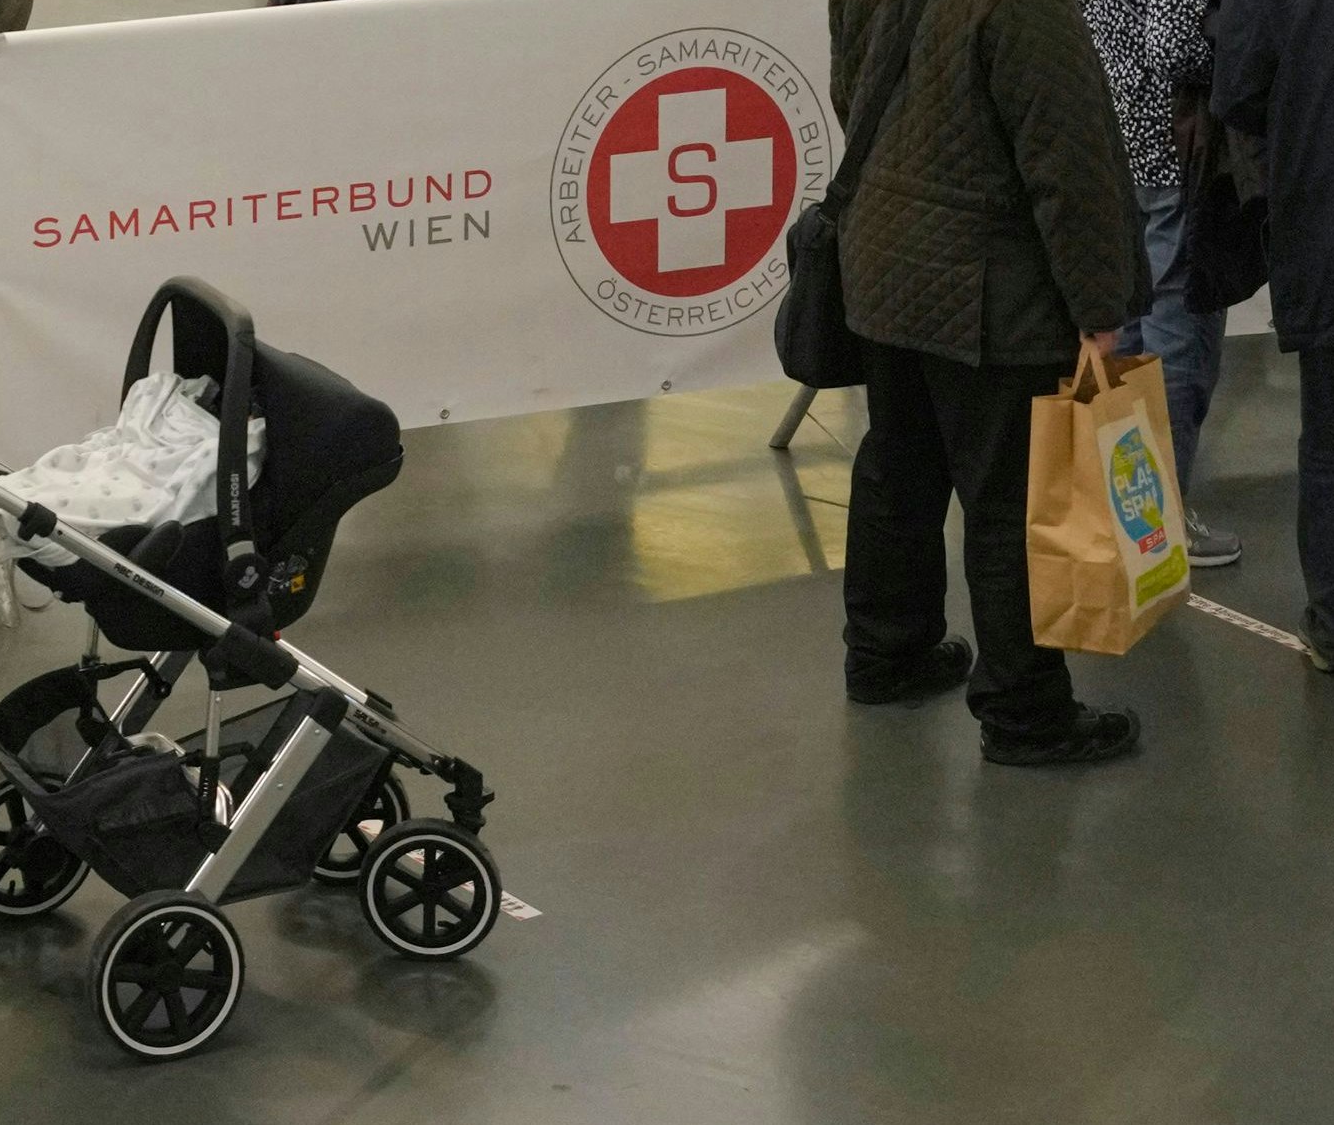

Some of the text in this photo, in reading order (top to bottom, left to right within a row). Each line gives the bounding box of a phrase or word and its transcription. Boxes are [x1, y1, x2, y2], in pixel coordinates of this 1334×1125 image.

[559, 85, 619, 244] ARBEITER
[636, 38, 800, 102] SAMARITER
[32, 169, 493, 249] SAMARITERBUND
[667, 142, 717, 218] S
[361, 210, 492, 252] WIEN
[596, 256, 788, 327] ÖSTERREICHS
[230, 473, 241, 526] MAXI-COSI
